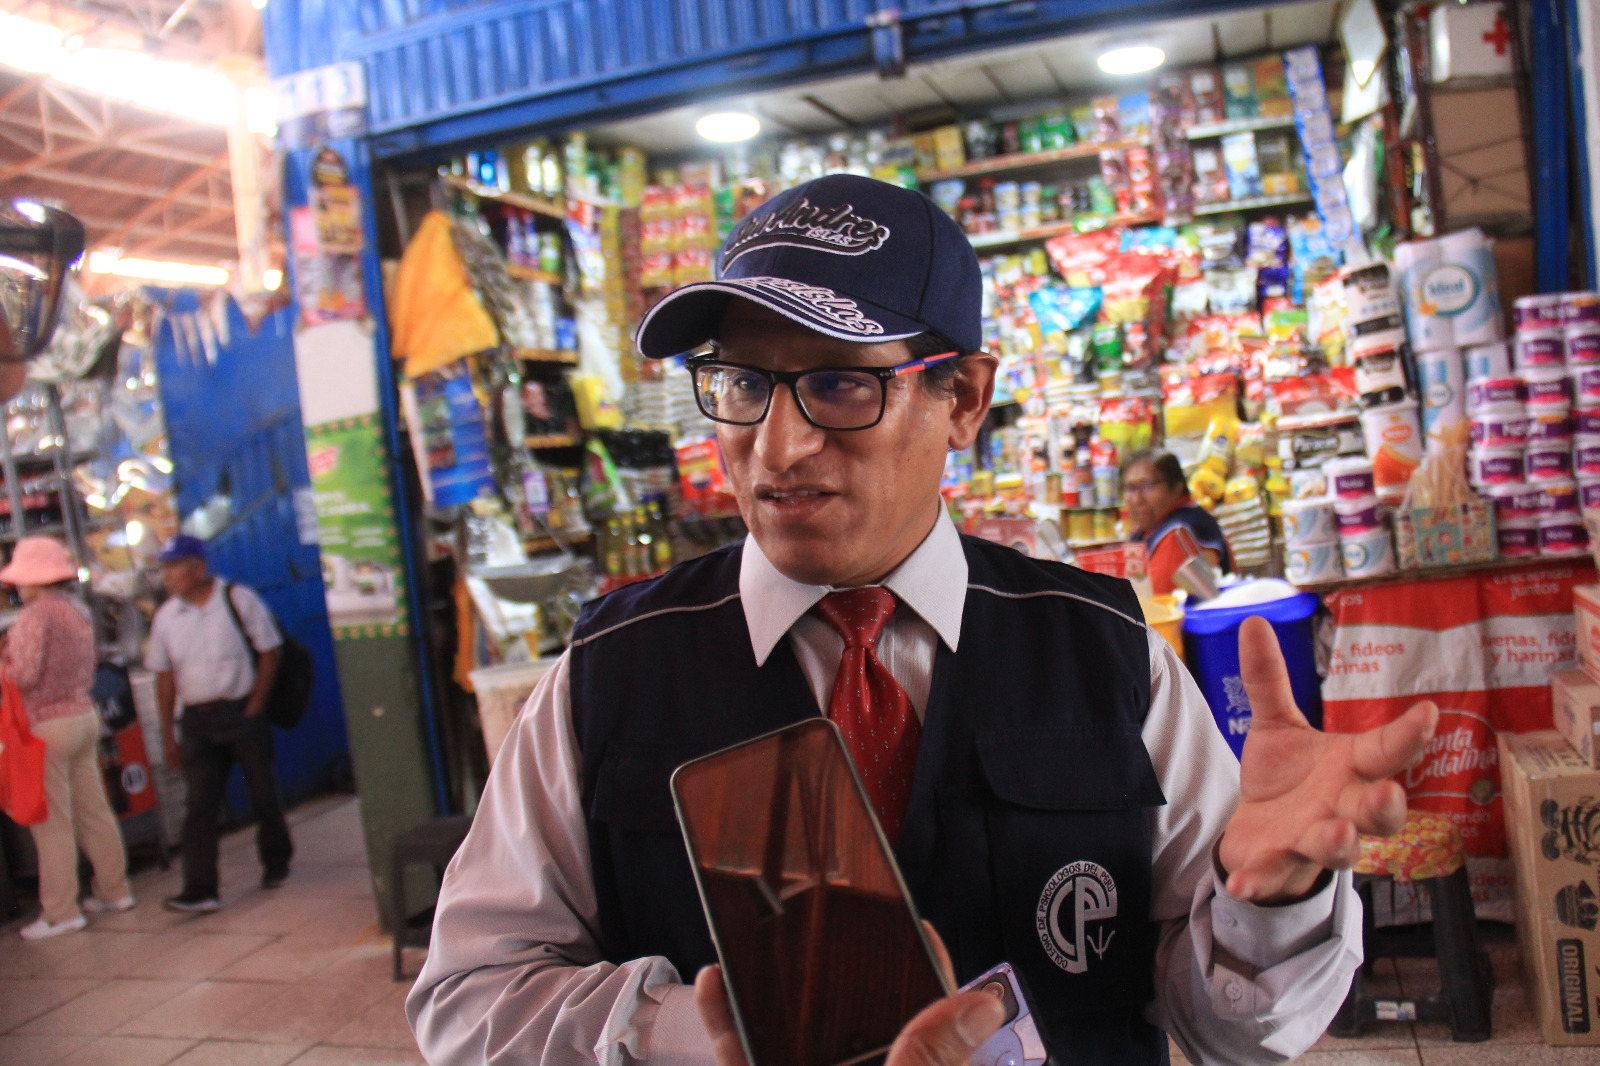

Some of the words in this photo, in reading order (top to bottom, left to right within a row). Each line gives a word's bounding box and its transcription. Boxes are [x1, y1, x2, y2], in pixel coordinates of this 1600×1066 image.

[807, 227, 853, 245] ISLAS
[1350, 641, 1405, 657] fideos
[1507, 649, 1575, 663] harinas
[1083, 862, 1098, 877] DEL
[1037, 916, 1046, 930] DE
[1041, 933, 1068, 969] COLEGIO
[1561, 944, 1584, 1026] ORIGINAL
